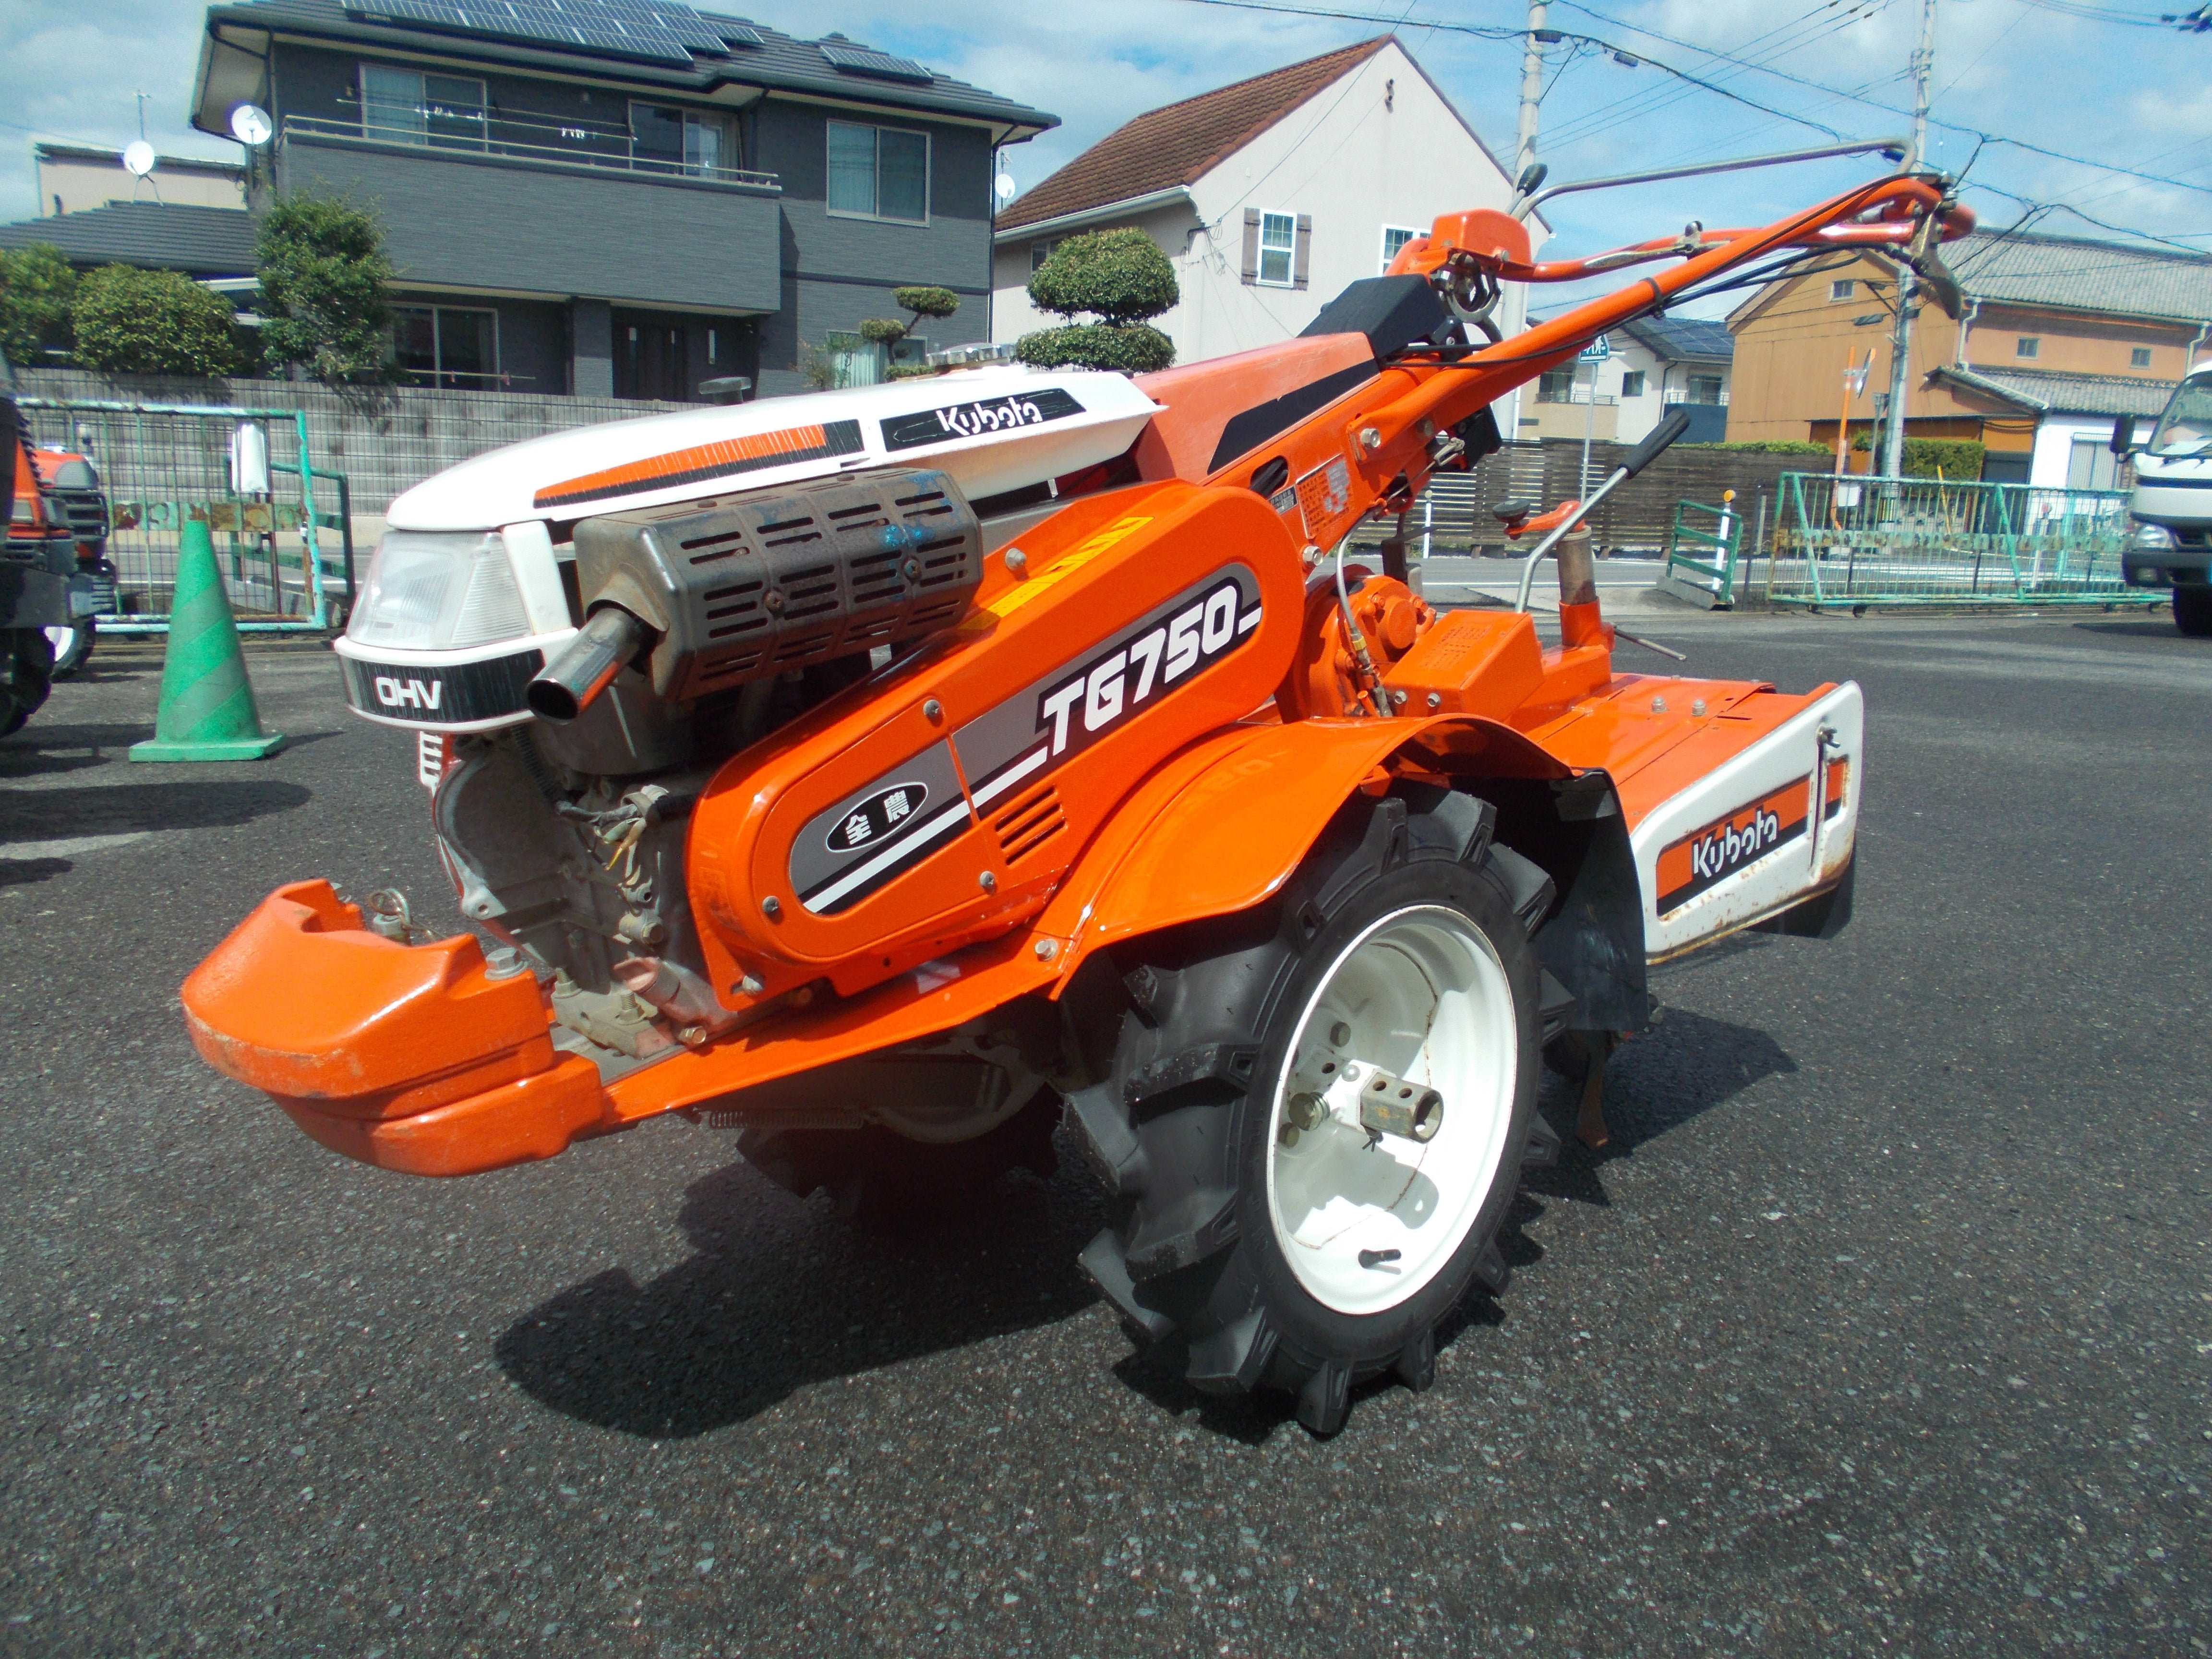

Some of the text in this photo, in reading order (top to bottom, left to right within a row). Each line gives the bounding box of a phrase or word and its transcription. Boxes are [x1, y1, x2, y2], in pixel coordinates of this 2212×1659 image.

[936, 397, 1042, 436] Kubota
[375, 677, 442, 709] OHV
[1043, 585, 1237, 756] TG750
[845, 790, 911, 845] 全農
[1693, 809, 1778, 878] Kubota
